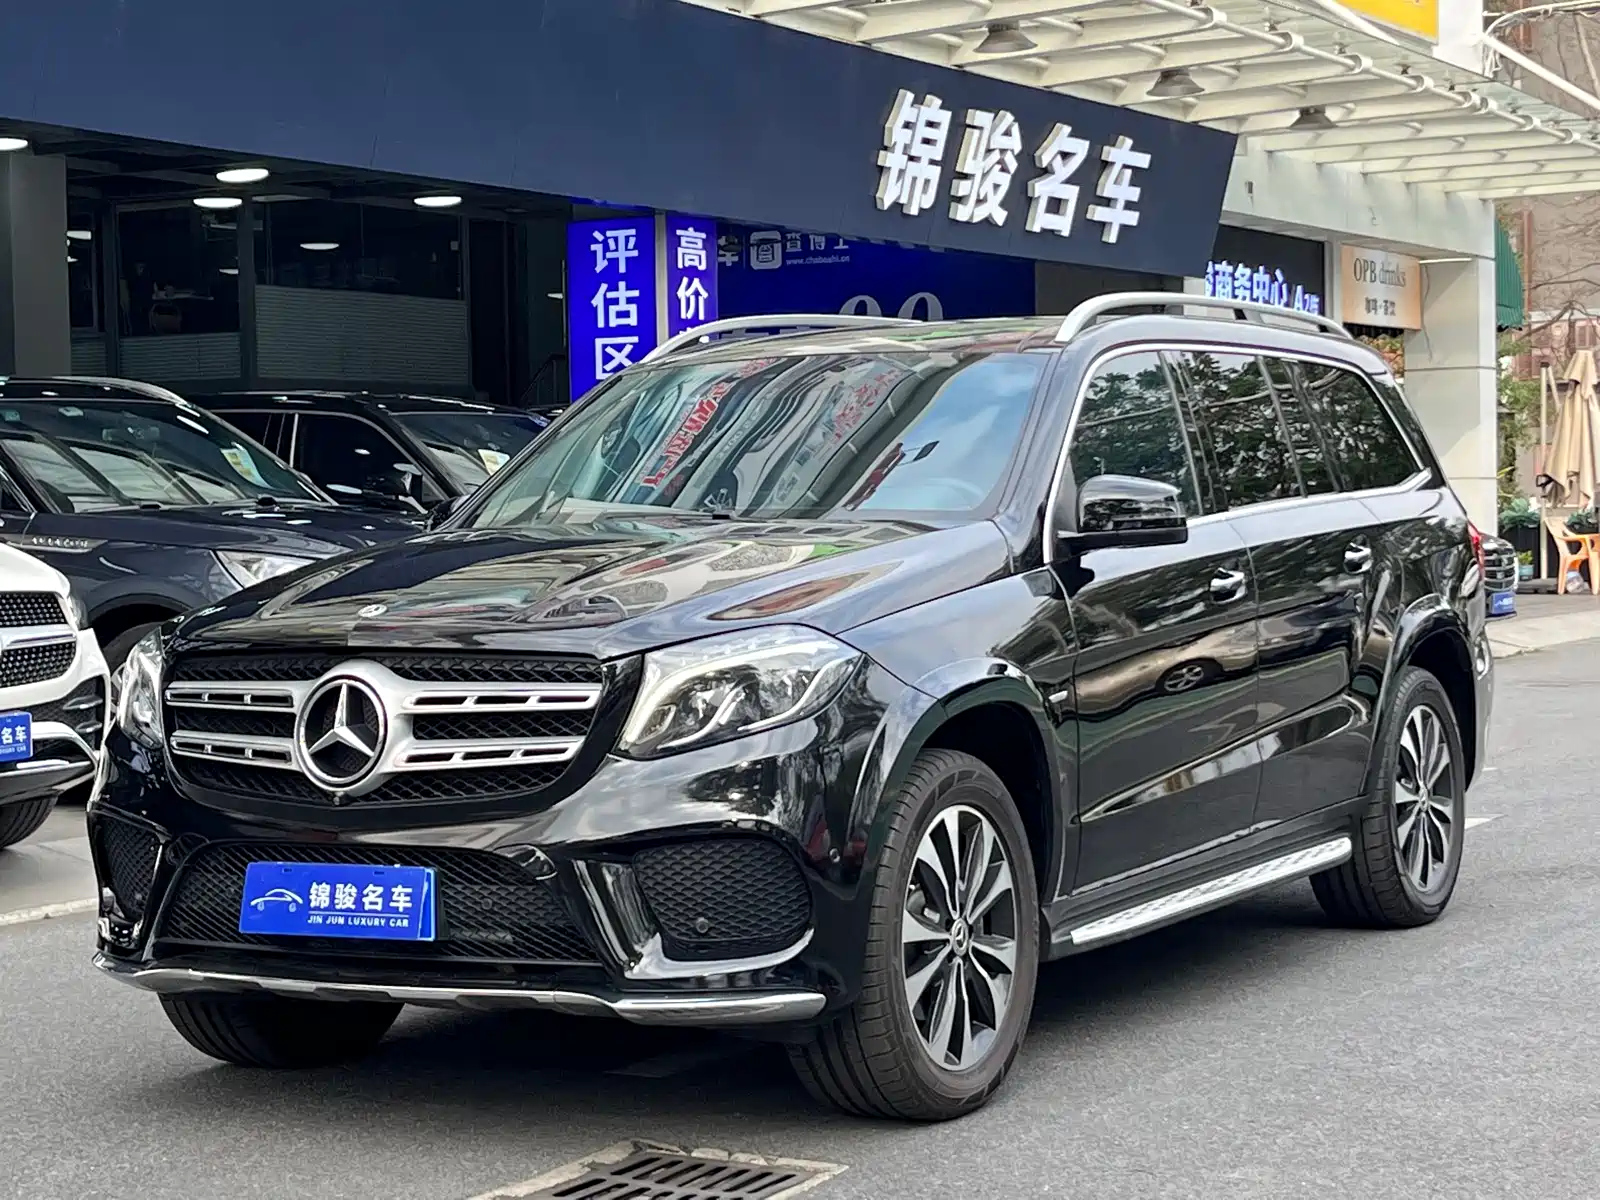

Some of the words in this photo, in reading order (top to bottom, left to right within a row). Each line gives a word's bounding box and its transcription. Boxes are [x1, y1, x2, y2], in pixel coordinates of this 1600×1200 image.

[875, 88, 1152, 244] 锦骏名车
[590, 228, 640, 380] 评估区
[676, 226, 709, 335] 高价
[1353, 257, 1376, 283] OPB
[308, 881, 413, 912] 锦骏名车
[308, 915, 323, 925] JIN
[326, 916, 344, 926] JUN
[348, 917, 386, 927] LUXURY
[389, 918, 409, 928] CAR
